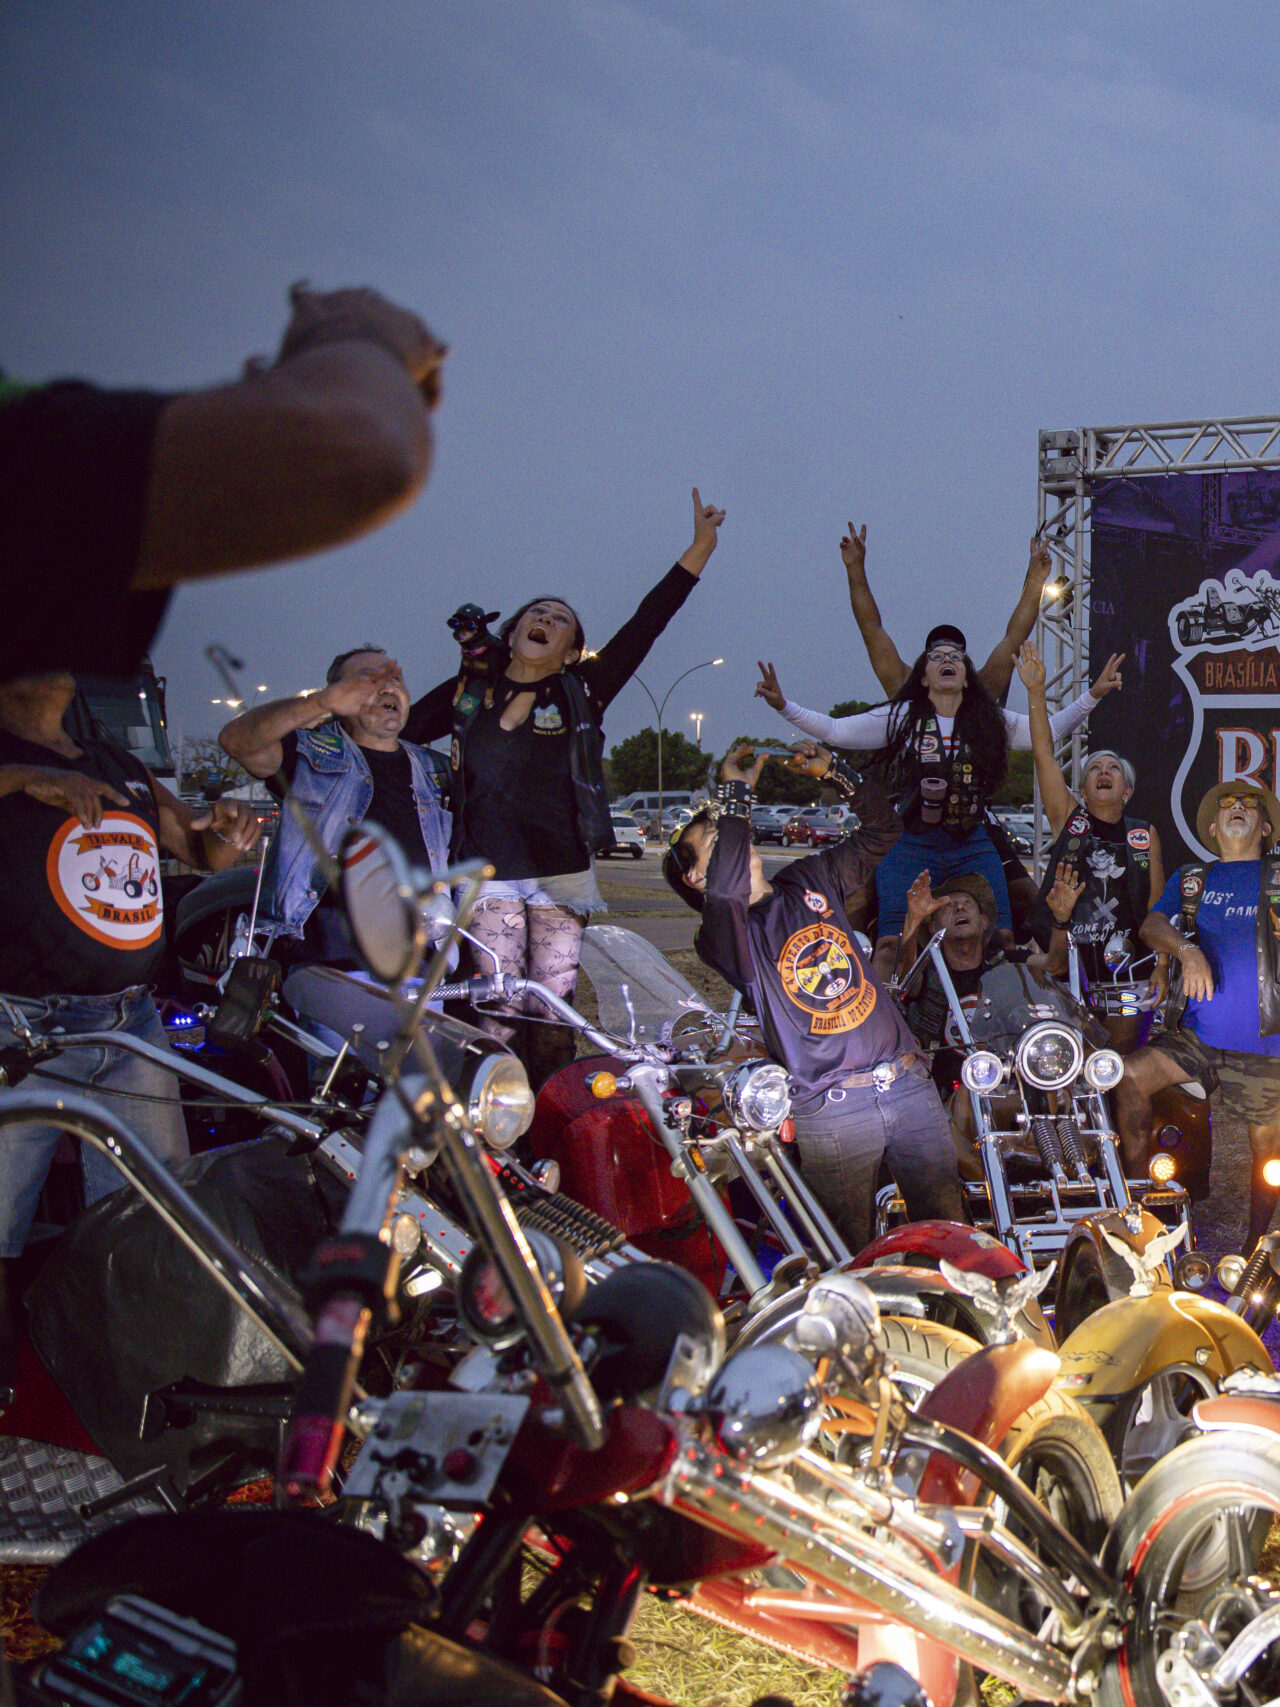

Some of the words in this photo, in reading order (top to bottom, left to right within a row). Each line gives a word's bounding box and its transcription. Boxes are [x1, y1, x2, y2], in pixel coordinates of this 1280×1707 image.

[1205, 656, 1278, 689] BRASÍLIA
[103, 908, 153, 922] BRASIL
[1073, 923, 1099, 934] COME
[1102, 921, 1115, 933] AS
